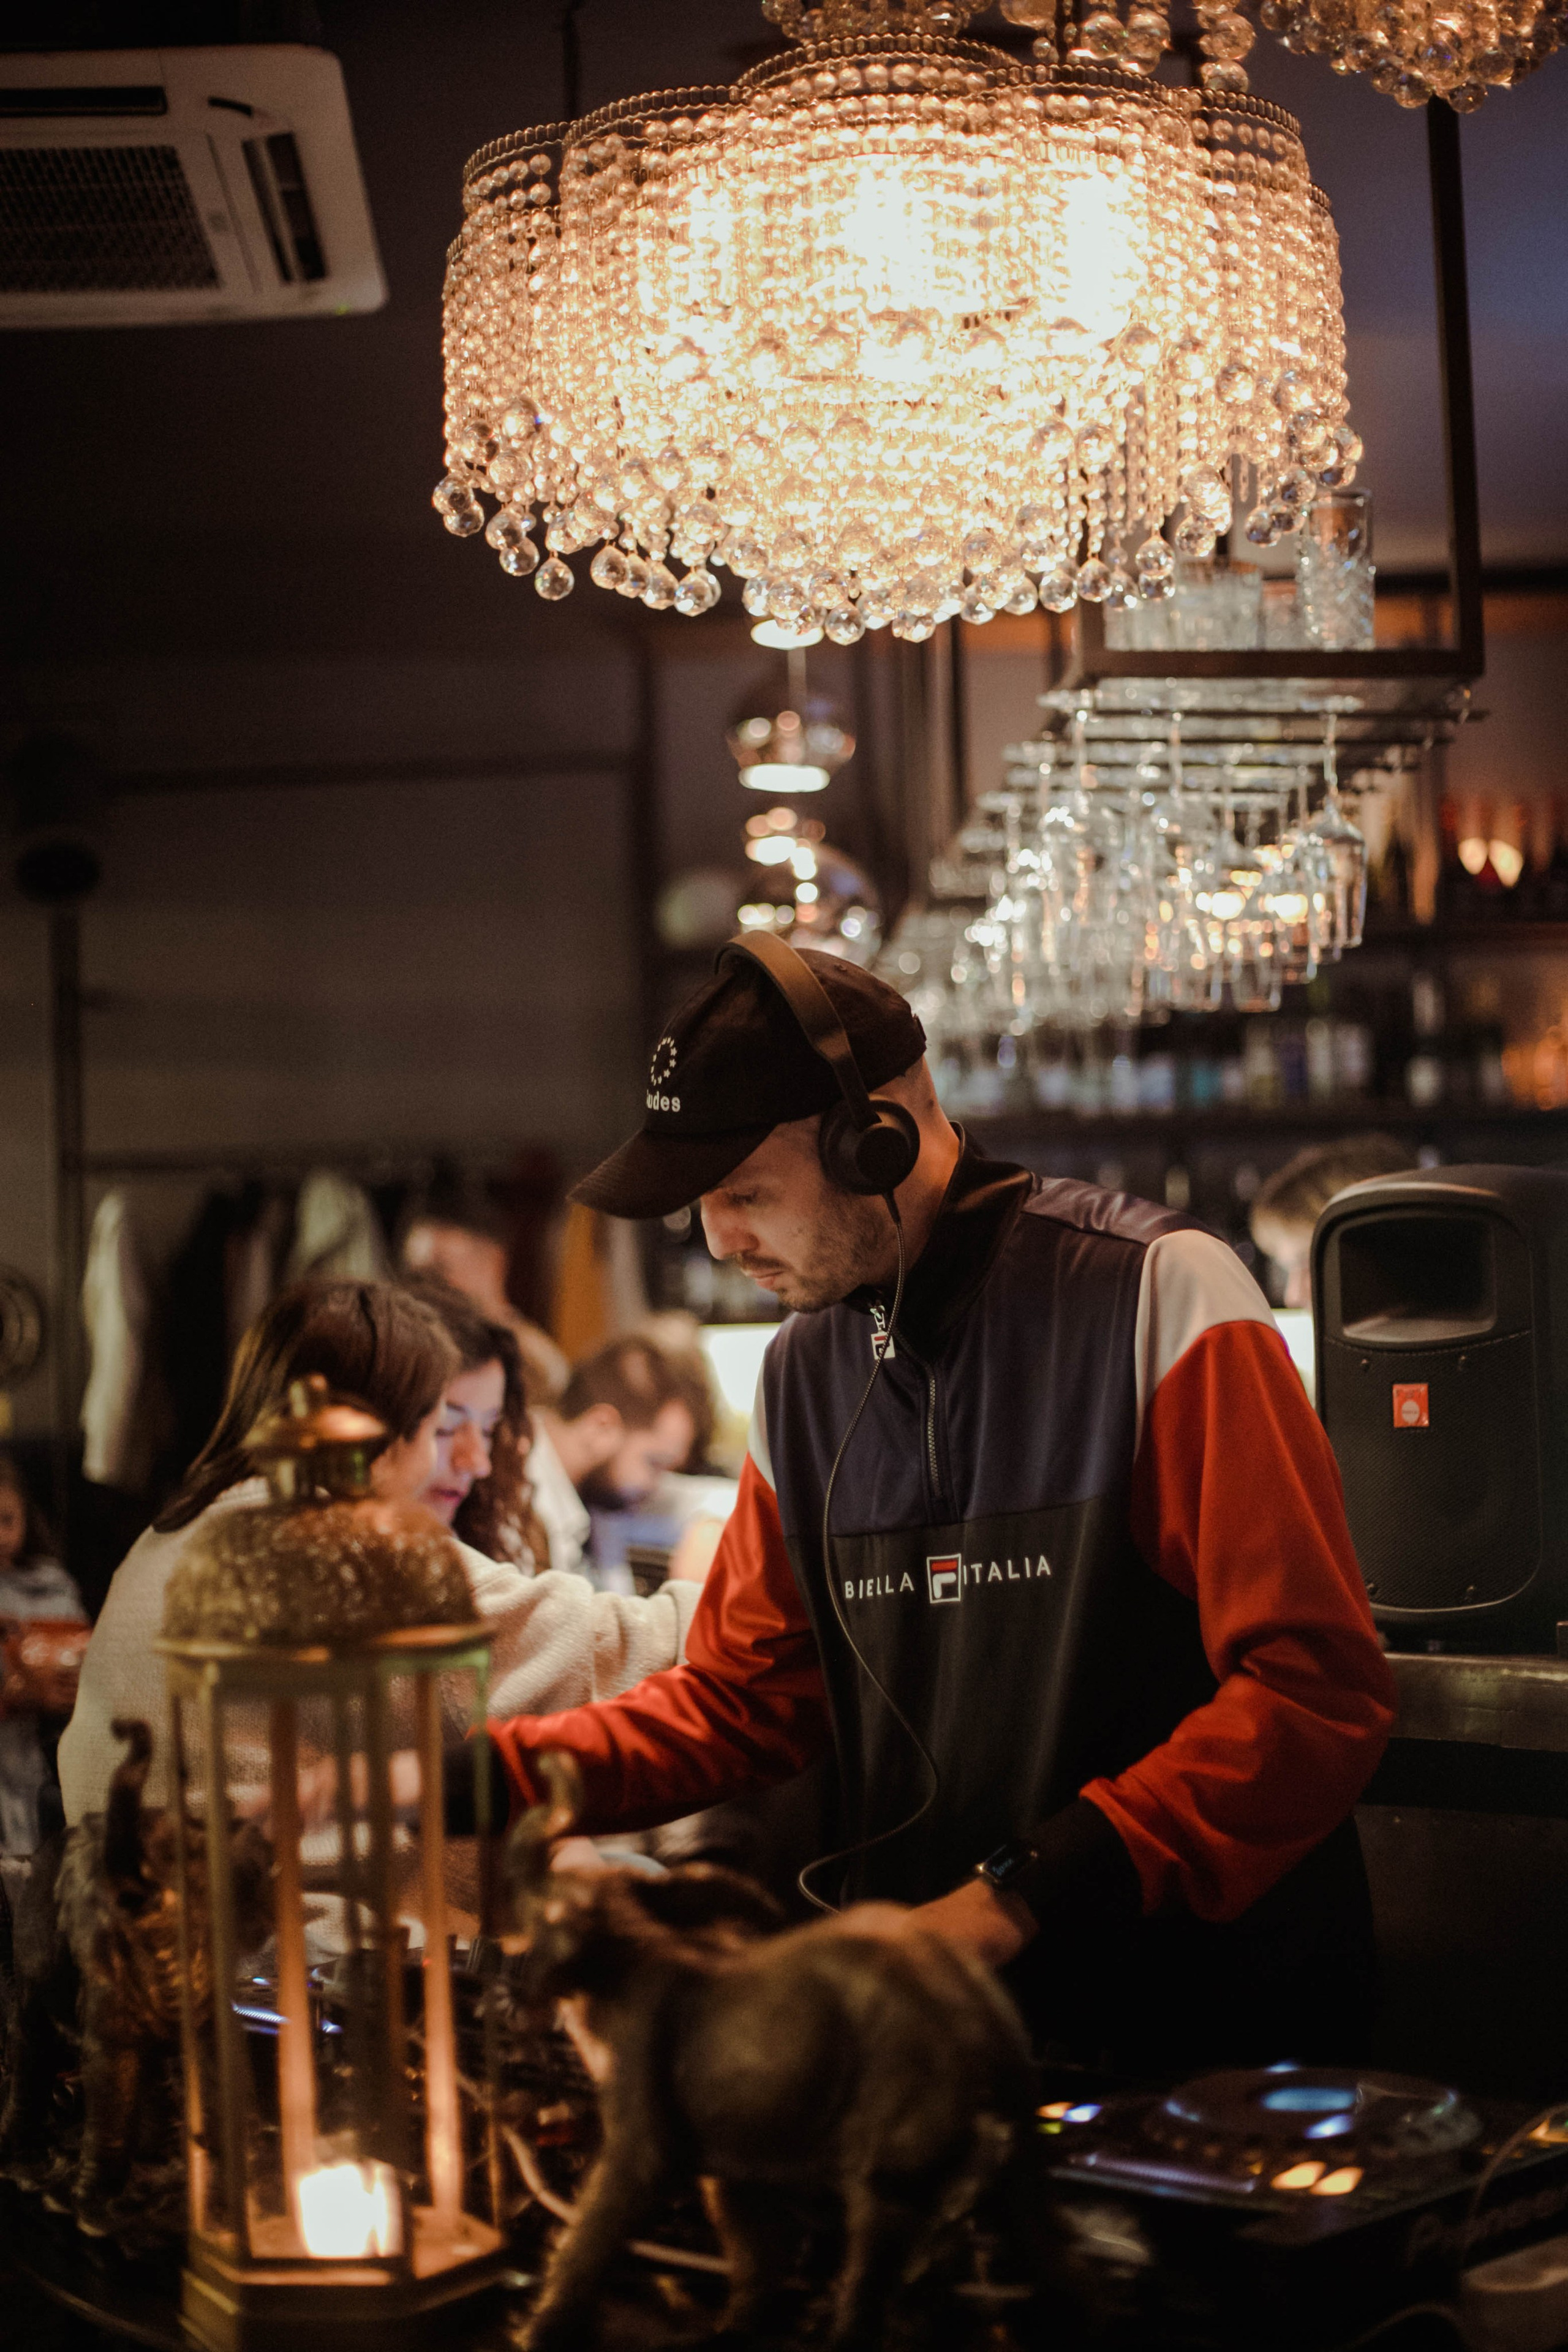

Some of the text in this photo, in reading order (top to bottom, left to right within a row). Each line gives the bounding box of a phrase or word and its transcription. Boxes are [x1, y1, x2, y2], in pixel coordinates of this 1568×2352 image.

[646, 1089, 680, 1112] udes
[845, 1572, 914, 1599] BIELLA
[963, 1555, 1052, 1585] ITALIA
